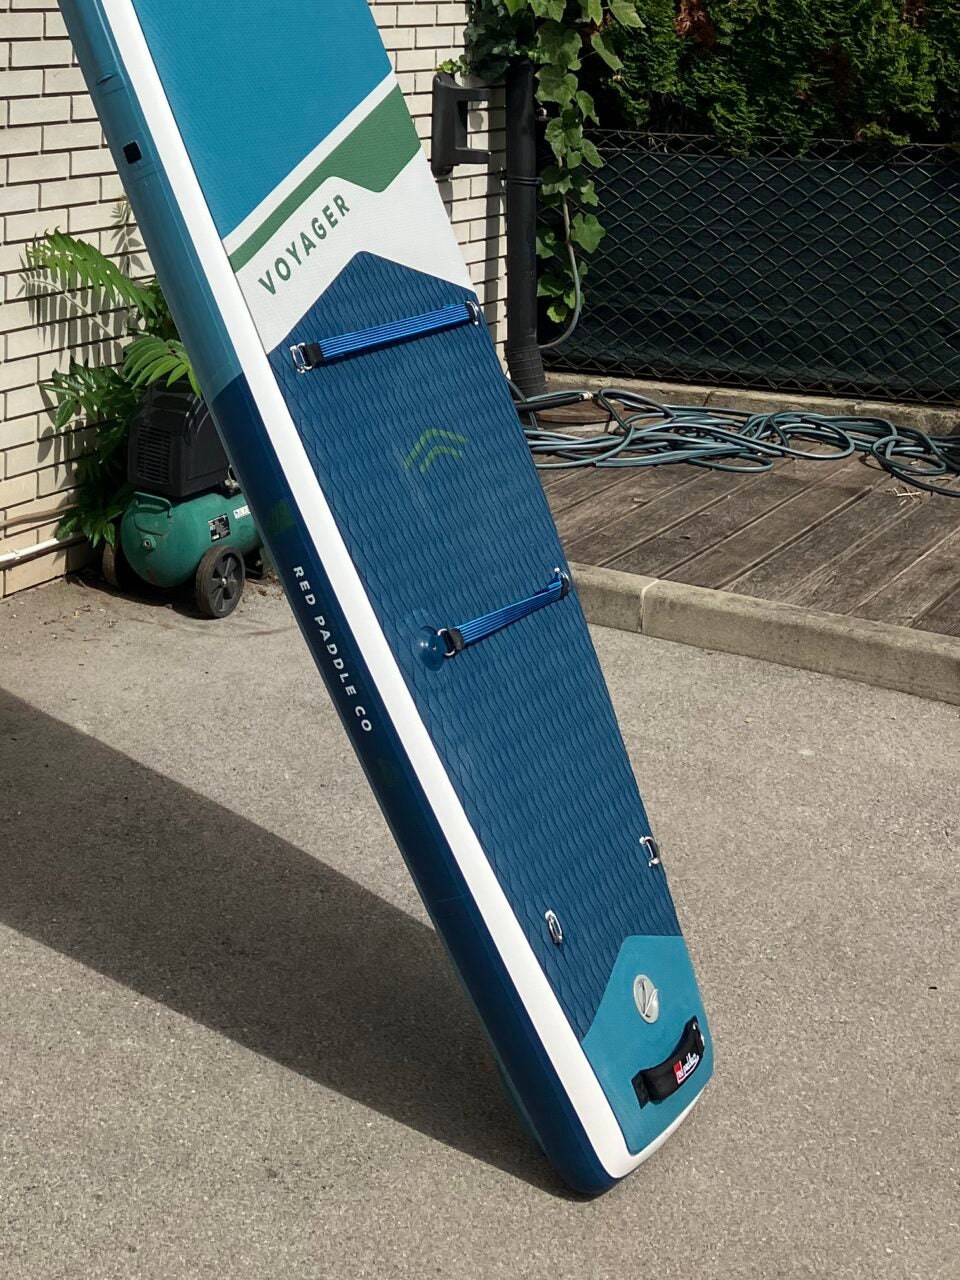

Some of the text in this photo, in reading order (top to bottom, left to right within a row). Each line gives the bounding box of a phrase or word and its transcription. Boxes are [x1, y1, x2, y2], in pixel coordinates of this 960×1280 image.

[258, 194, 350, 296] VOYAGER
[293, 566, 373, 732] RED PADDLE CO
